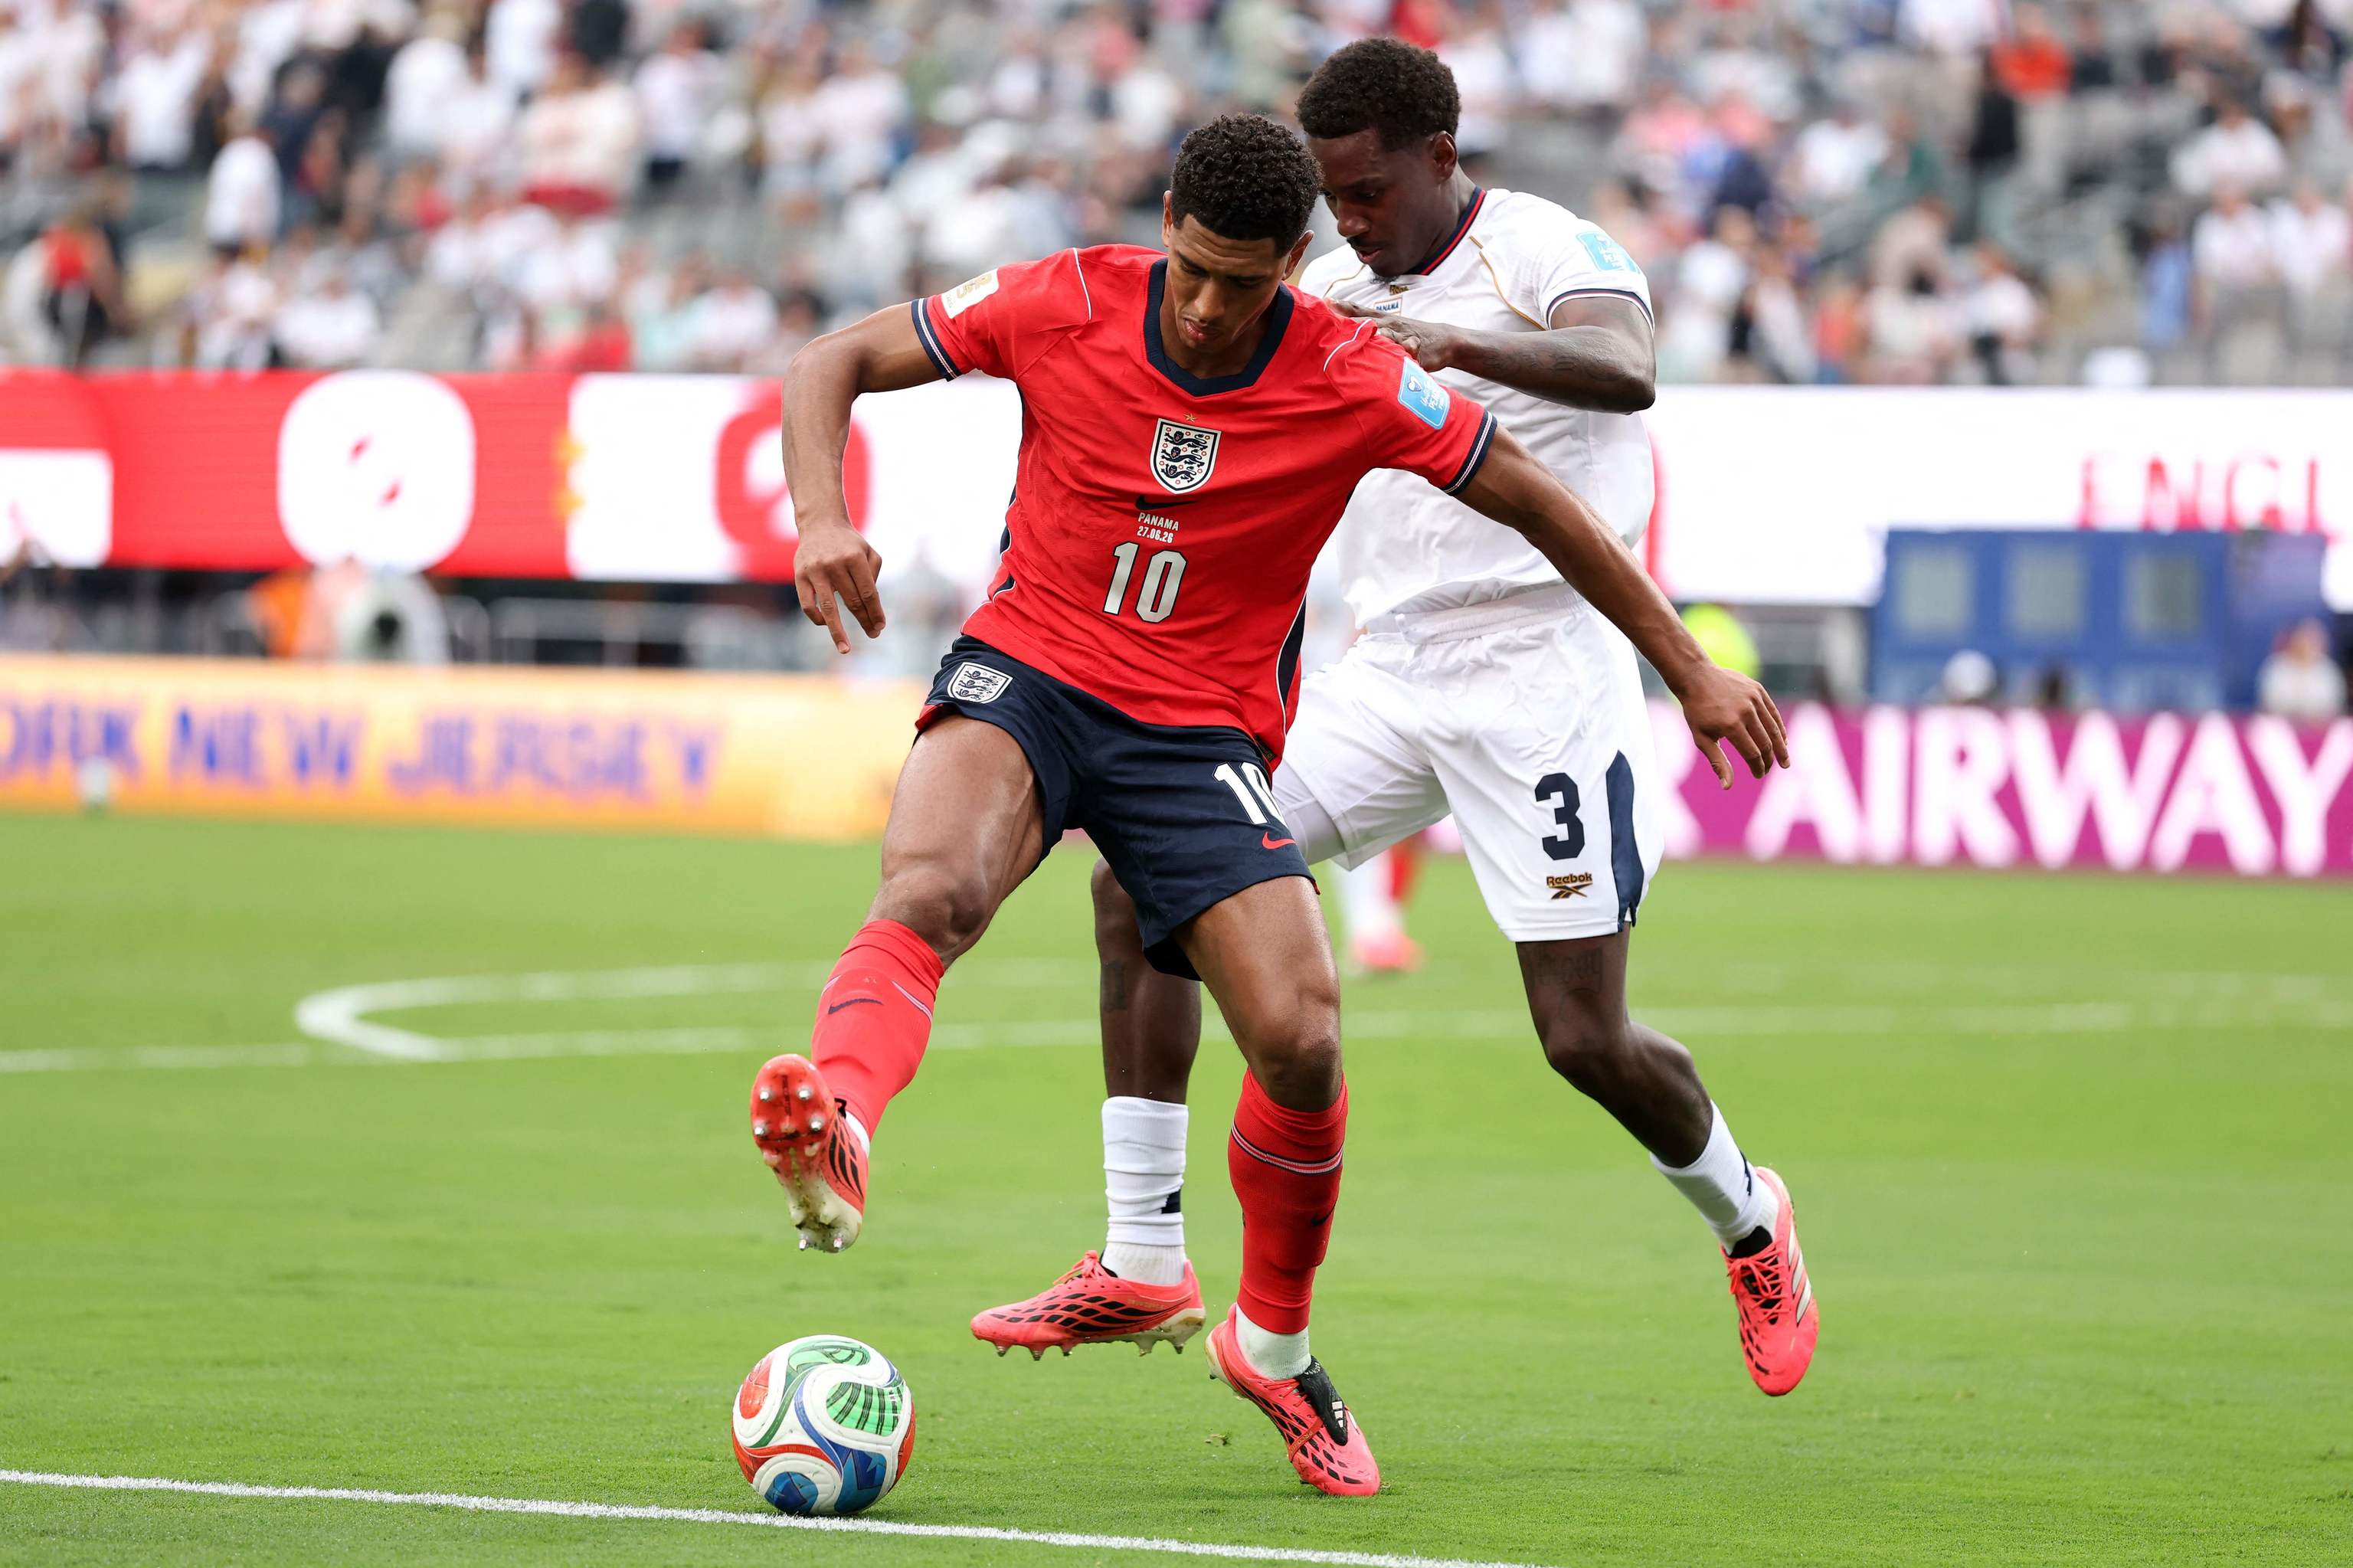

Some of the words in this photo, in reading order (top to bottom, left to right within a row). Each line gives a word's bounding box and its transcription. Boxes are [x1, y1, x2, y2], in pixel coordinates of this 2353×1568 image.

[1136, 525, 1174, 544] 27.06.26
[1137, 512, 1180, 532] PANAMA
[1103, 541, 1187, 624] 10
[170, 702, 363, 789] NEW
[389, 709, 722, 801] JERSEY
[1743, 699, 2353, 878] AIRWAY
[1534, 772, 1586, 861] 3
[1546, 872, 1593, 887] Reebok
